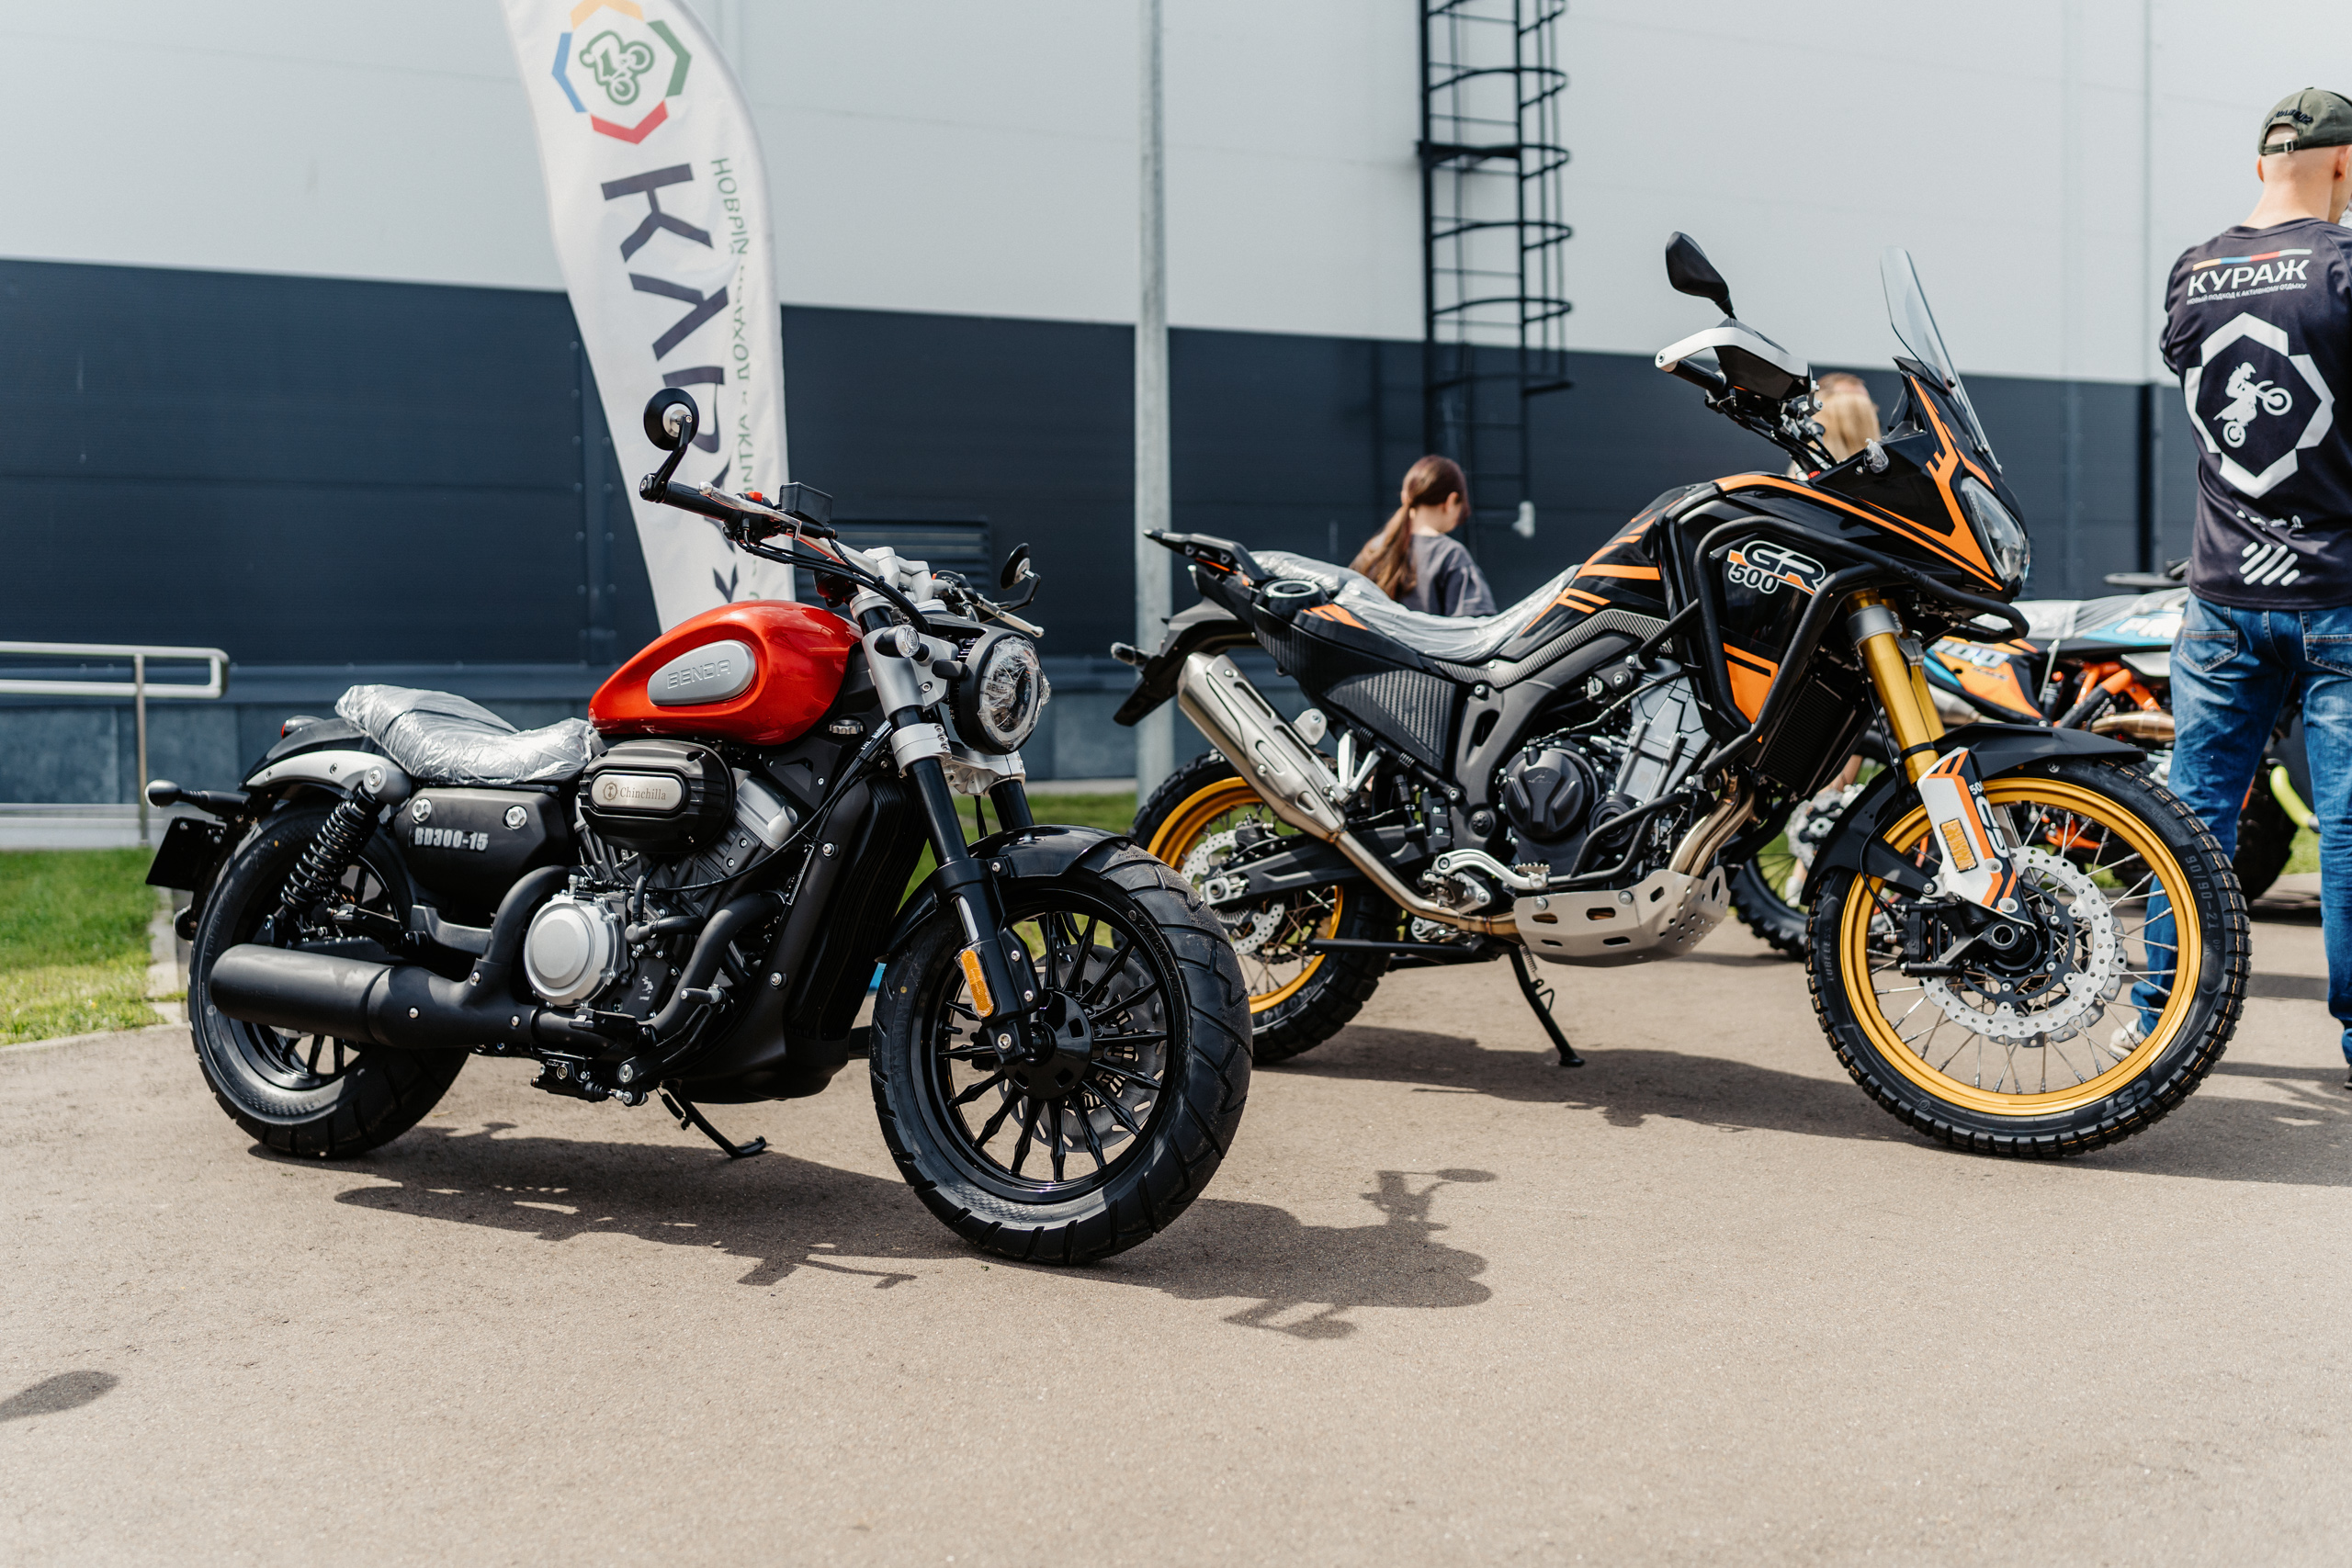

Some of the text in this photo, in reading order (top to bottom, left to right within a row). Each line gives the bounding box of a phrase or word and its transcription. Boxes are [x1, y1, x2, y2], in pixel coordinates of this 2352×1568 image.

[2188, 259, 2310, 297] КУРАЖ
[1729, 562, 1779, 593] 500
[1743, 541, 1825, 591] GR
[667, 659, 731, 690] BENDA
[619, 786, 667, 801] Chinchilla
[1969, 781, 1984, 795] 50
[414, 826, 490, 852] BD300-15
[2185, 855, 2220, 930] 90/90-21
[1823, 925, 1835, 983] TUBELESS
[2101, 1079, 2152, 1119] CST
